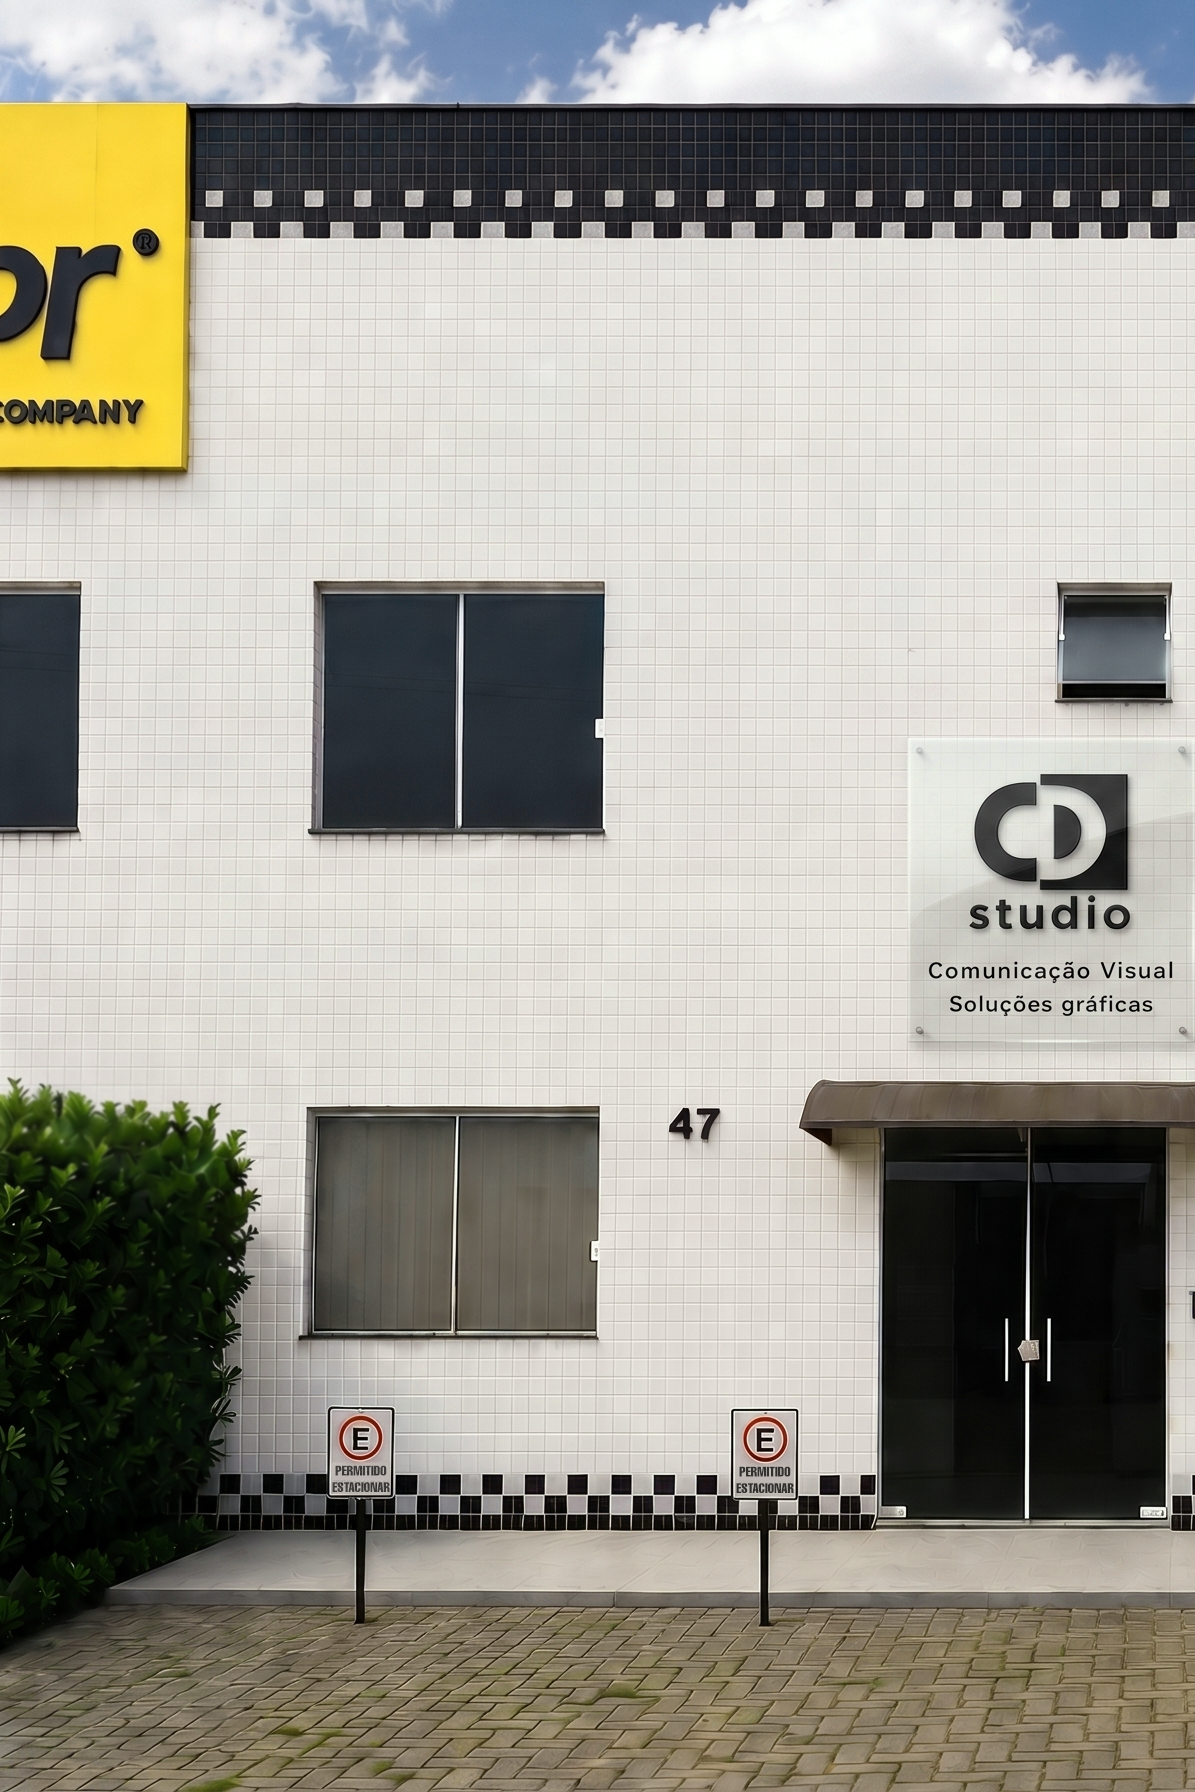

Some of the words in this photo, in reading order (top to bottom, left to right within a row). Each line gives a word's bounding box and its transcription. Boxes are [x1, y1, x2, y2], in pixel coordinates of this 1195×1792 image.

[0, 399, 144, 425] OMPANY
[973, 773, 1129, 891] CD
[969, 895, 1131, 930] studio
[928, 961, 1090, 984] Comunicação
[1100, 961, 1174, 980] Visual
[949, 995, 1053, 1017] Soluções
[1061, 994, 1154, 1017] gráficas
[668, 1107, 721, 1141] 47
[352, 1427, 370, 1451] E
[756, 1427, 775, 1452] E
[335, 1465, 387, 1476] PERMITIDO
[739, 1466, 791, 1477] PERMITIDO
[332, 1481, 390, 1493] ESTACIONAR
[736, 1482, 795, 1494] ESTACIONAR
